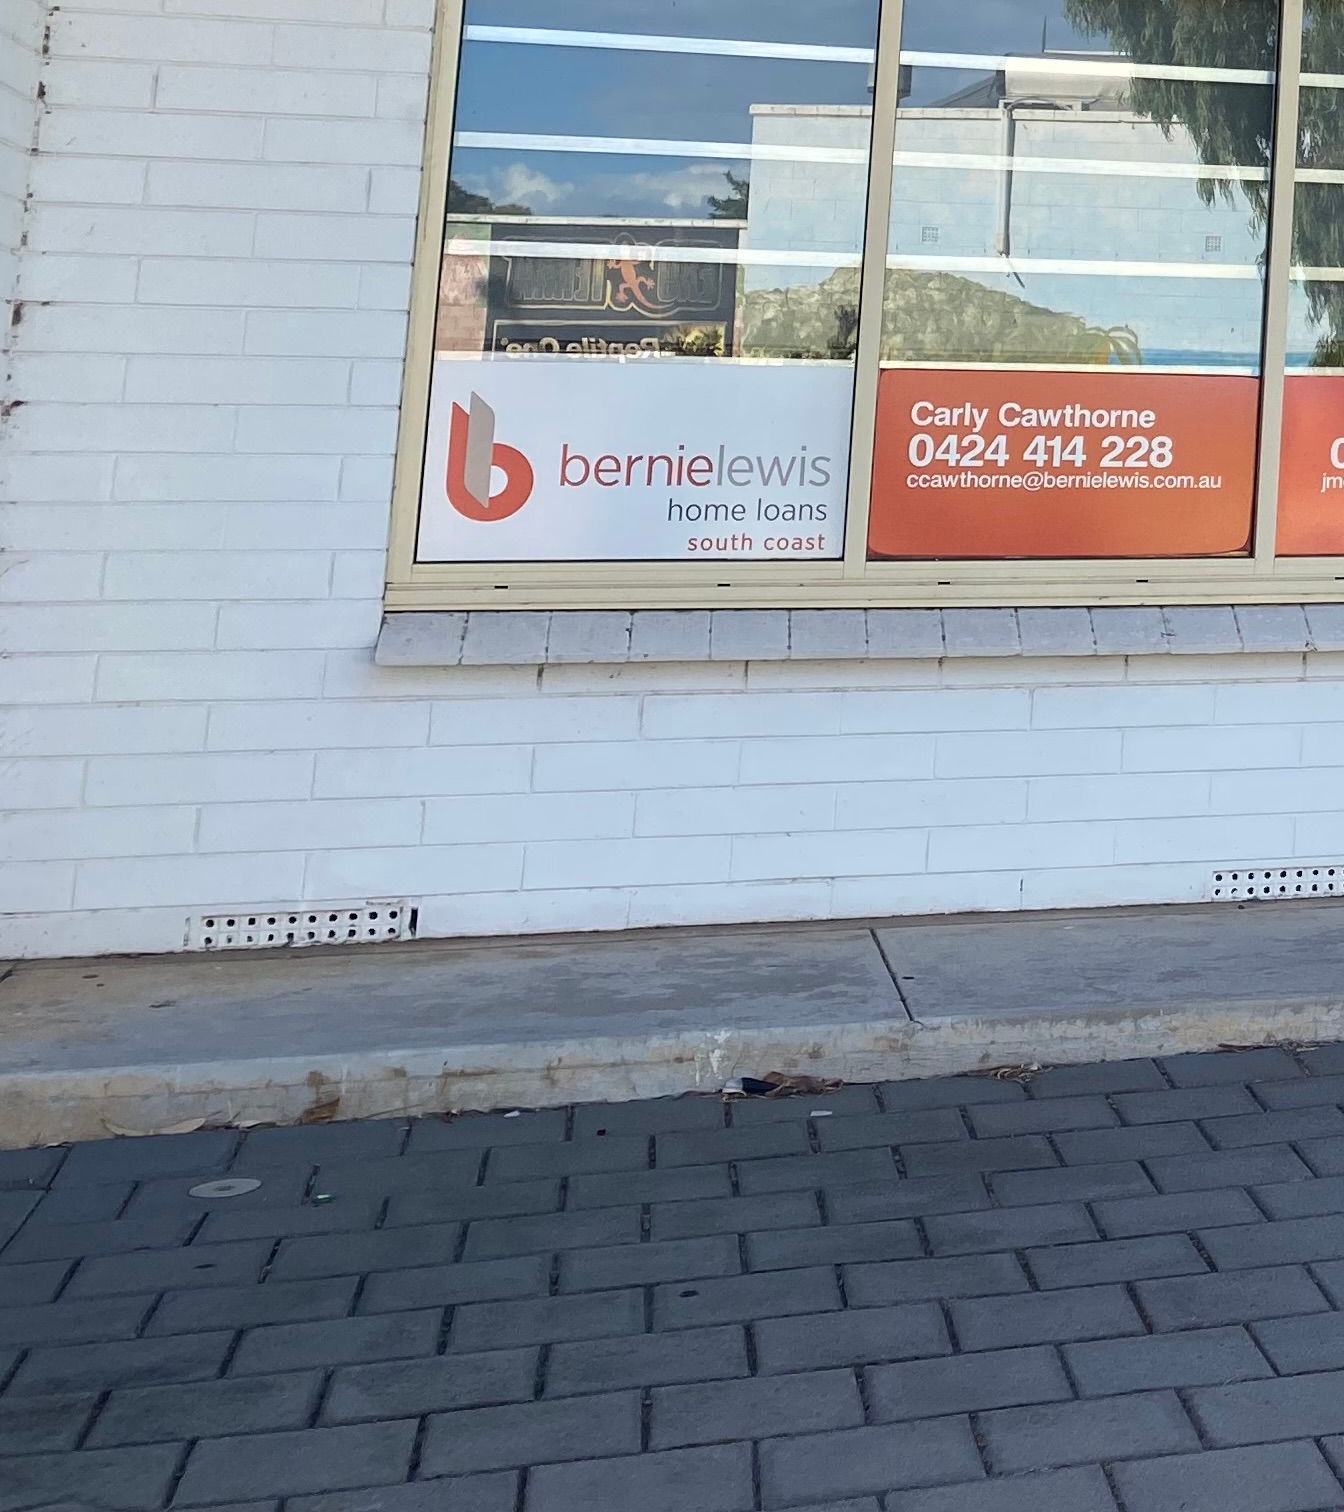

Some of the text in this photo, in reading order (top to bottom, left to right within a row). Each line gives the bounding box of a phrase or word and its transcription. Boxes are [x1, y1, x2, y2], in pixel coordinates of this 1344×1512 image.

[911, 400, 1156, 431] Carly Cawthorne
[558, 442, 832, 487] bernielewis
[908, 433, 1173, 469] 0424 414 228
[906, 470, 1222, 491] ccawthorne@bernielewis.com.au
[667, 497, 828, 522] home loans
[687, 532, 826, 551] south coast
